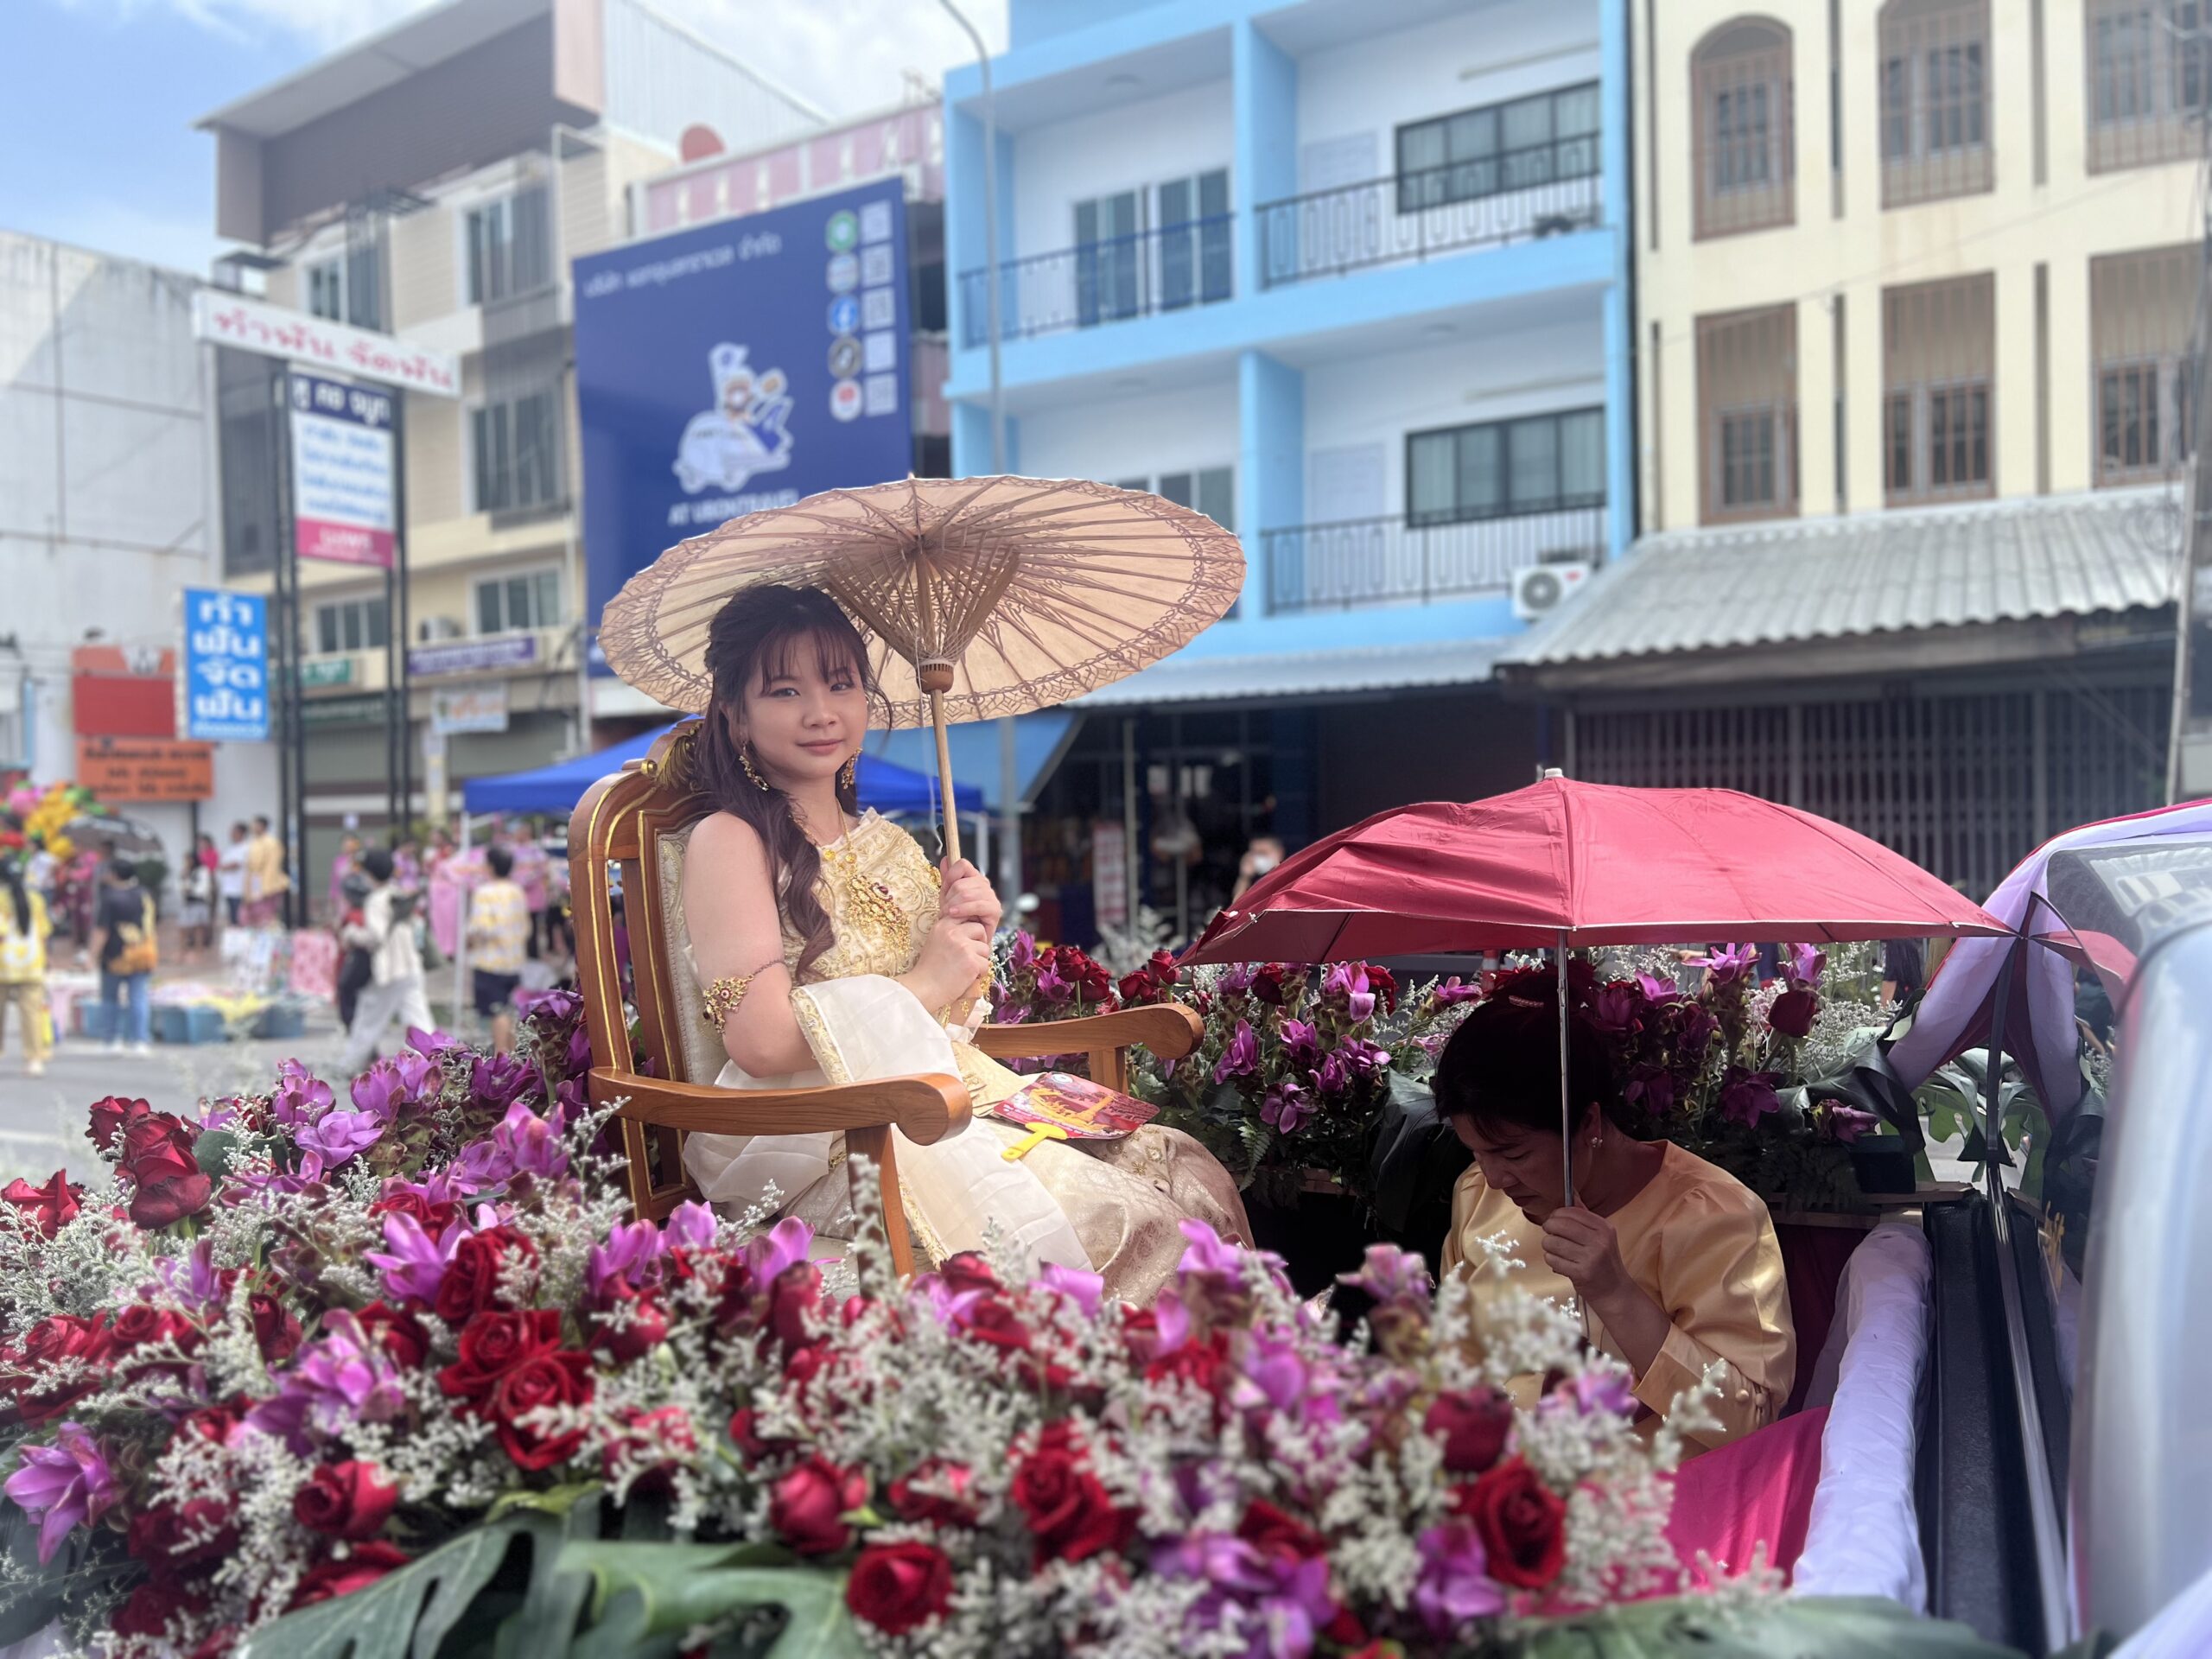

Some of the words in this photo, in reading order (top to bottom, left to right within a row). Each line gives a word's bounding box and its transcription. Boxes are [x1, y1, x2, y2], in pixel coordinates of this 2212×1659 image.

[199, 591, 253, 627] ทำ
[193, 625, 261, 658] ฟัน
[195, 655, 261, 689] จัด
[194, 688, 263, 721] ฟัน
